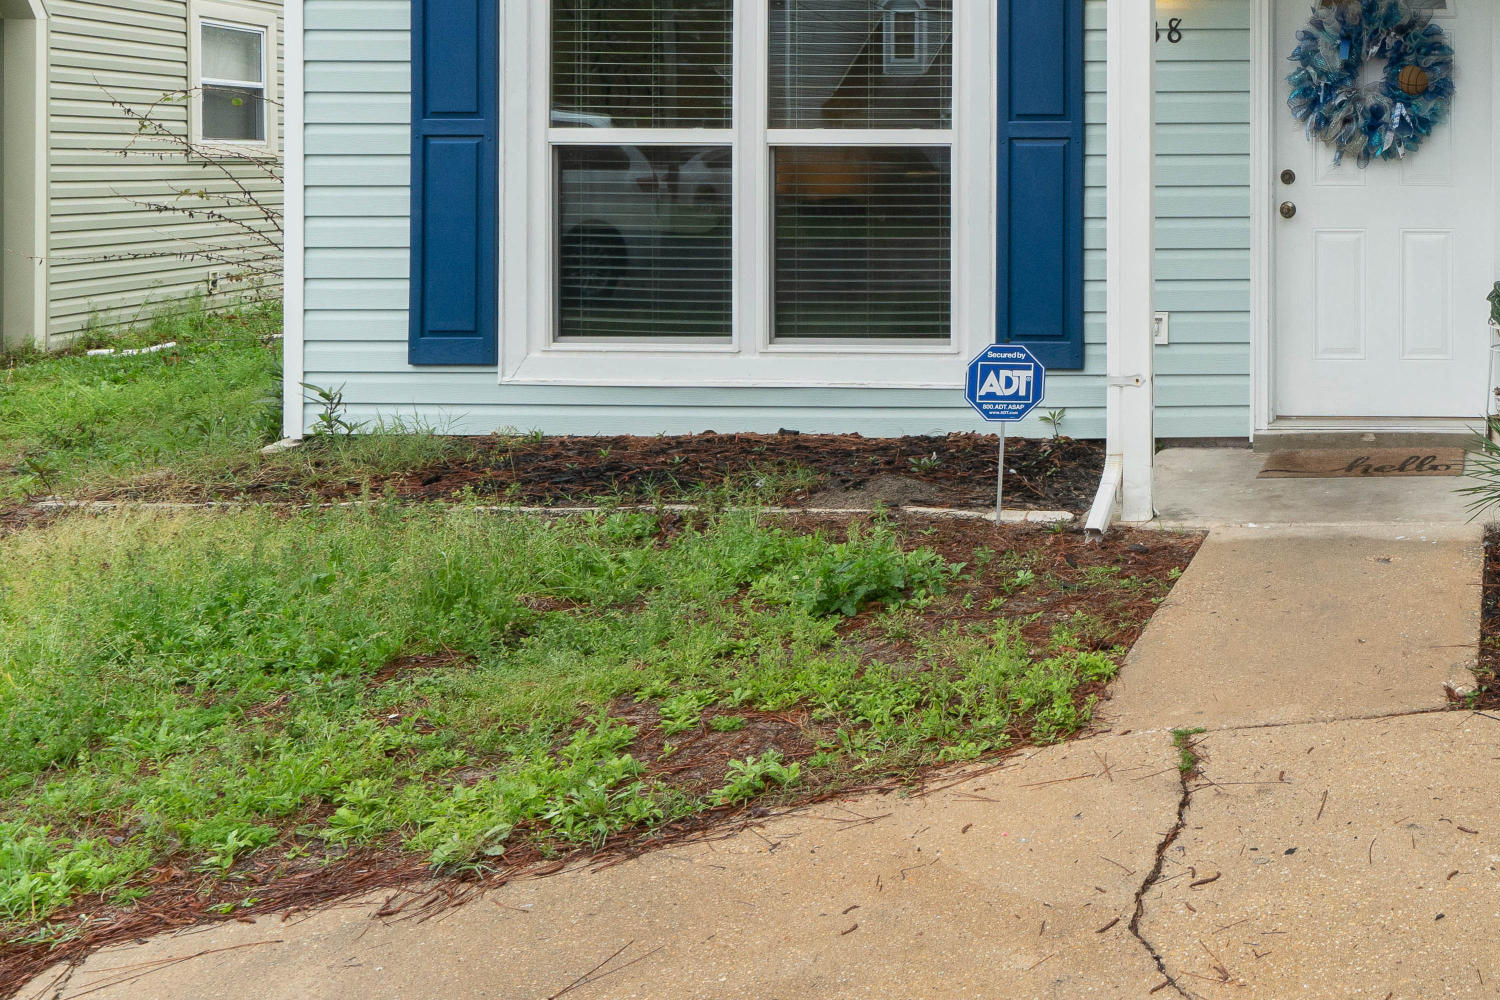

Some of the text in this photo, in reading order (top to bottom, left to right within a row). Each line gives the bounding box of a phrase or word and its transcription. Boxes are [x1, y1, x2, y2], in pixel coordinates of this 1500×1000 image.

[1156, 18, 1182, 43] 8
[987, 351, 1026, 360] Secured by
[978, 369, 1033, 396] ADT
[1325, 455, 1451, 475] hello
